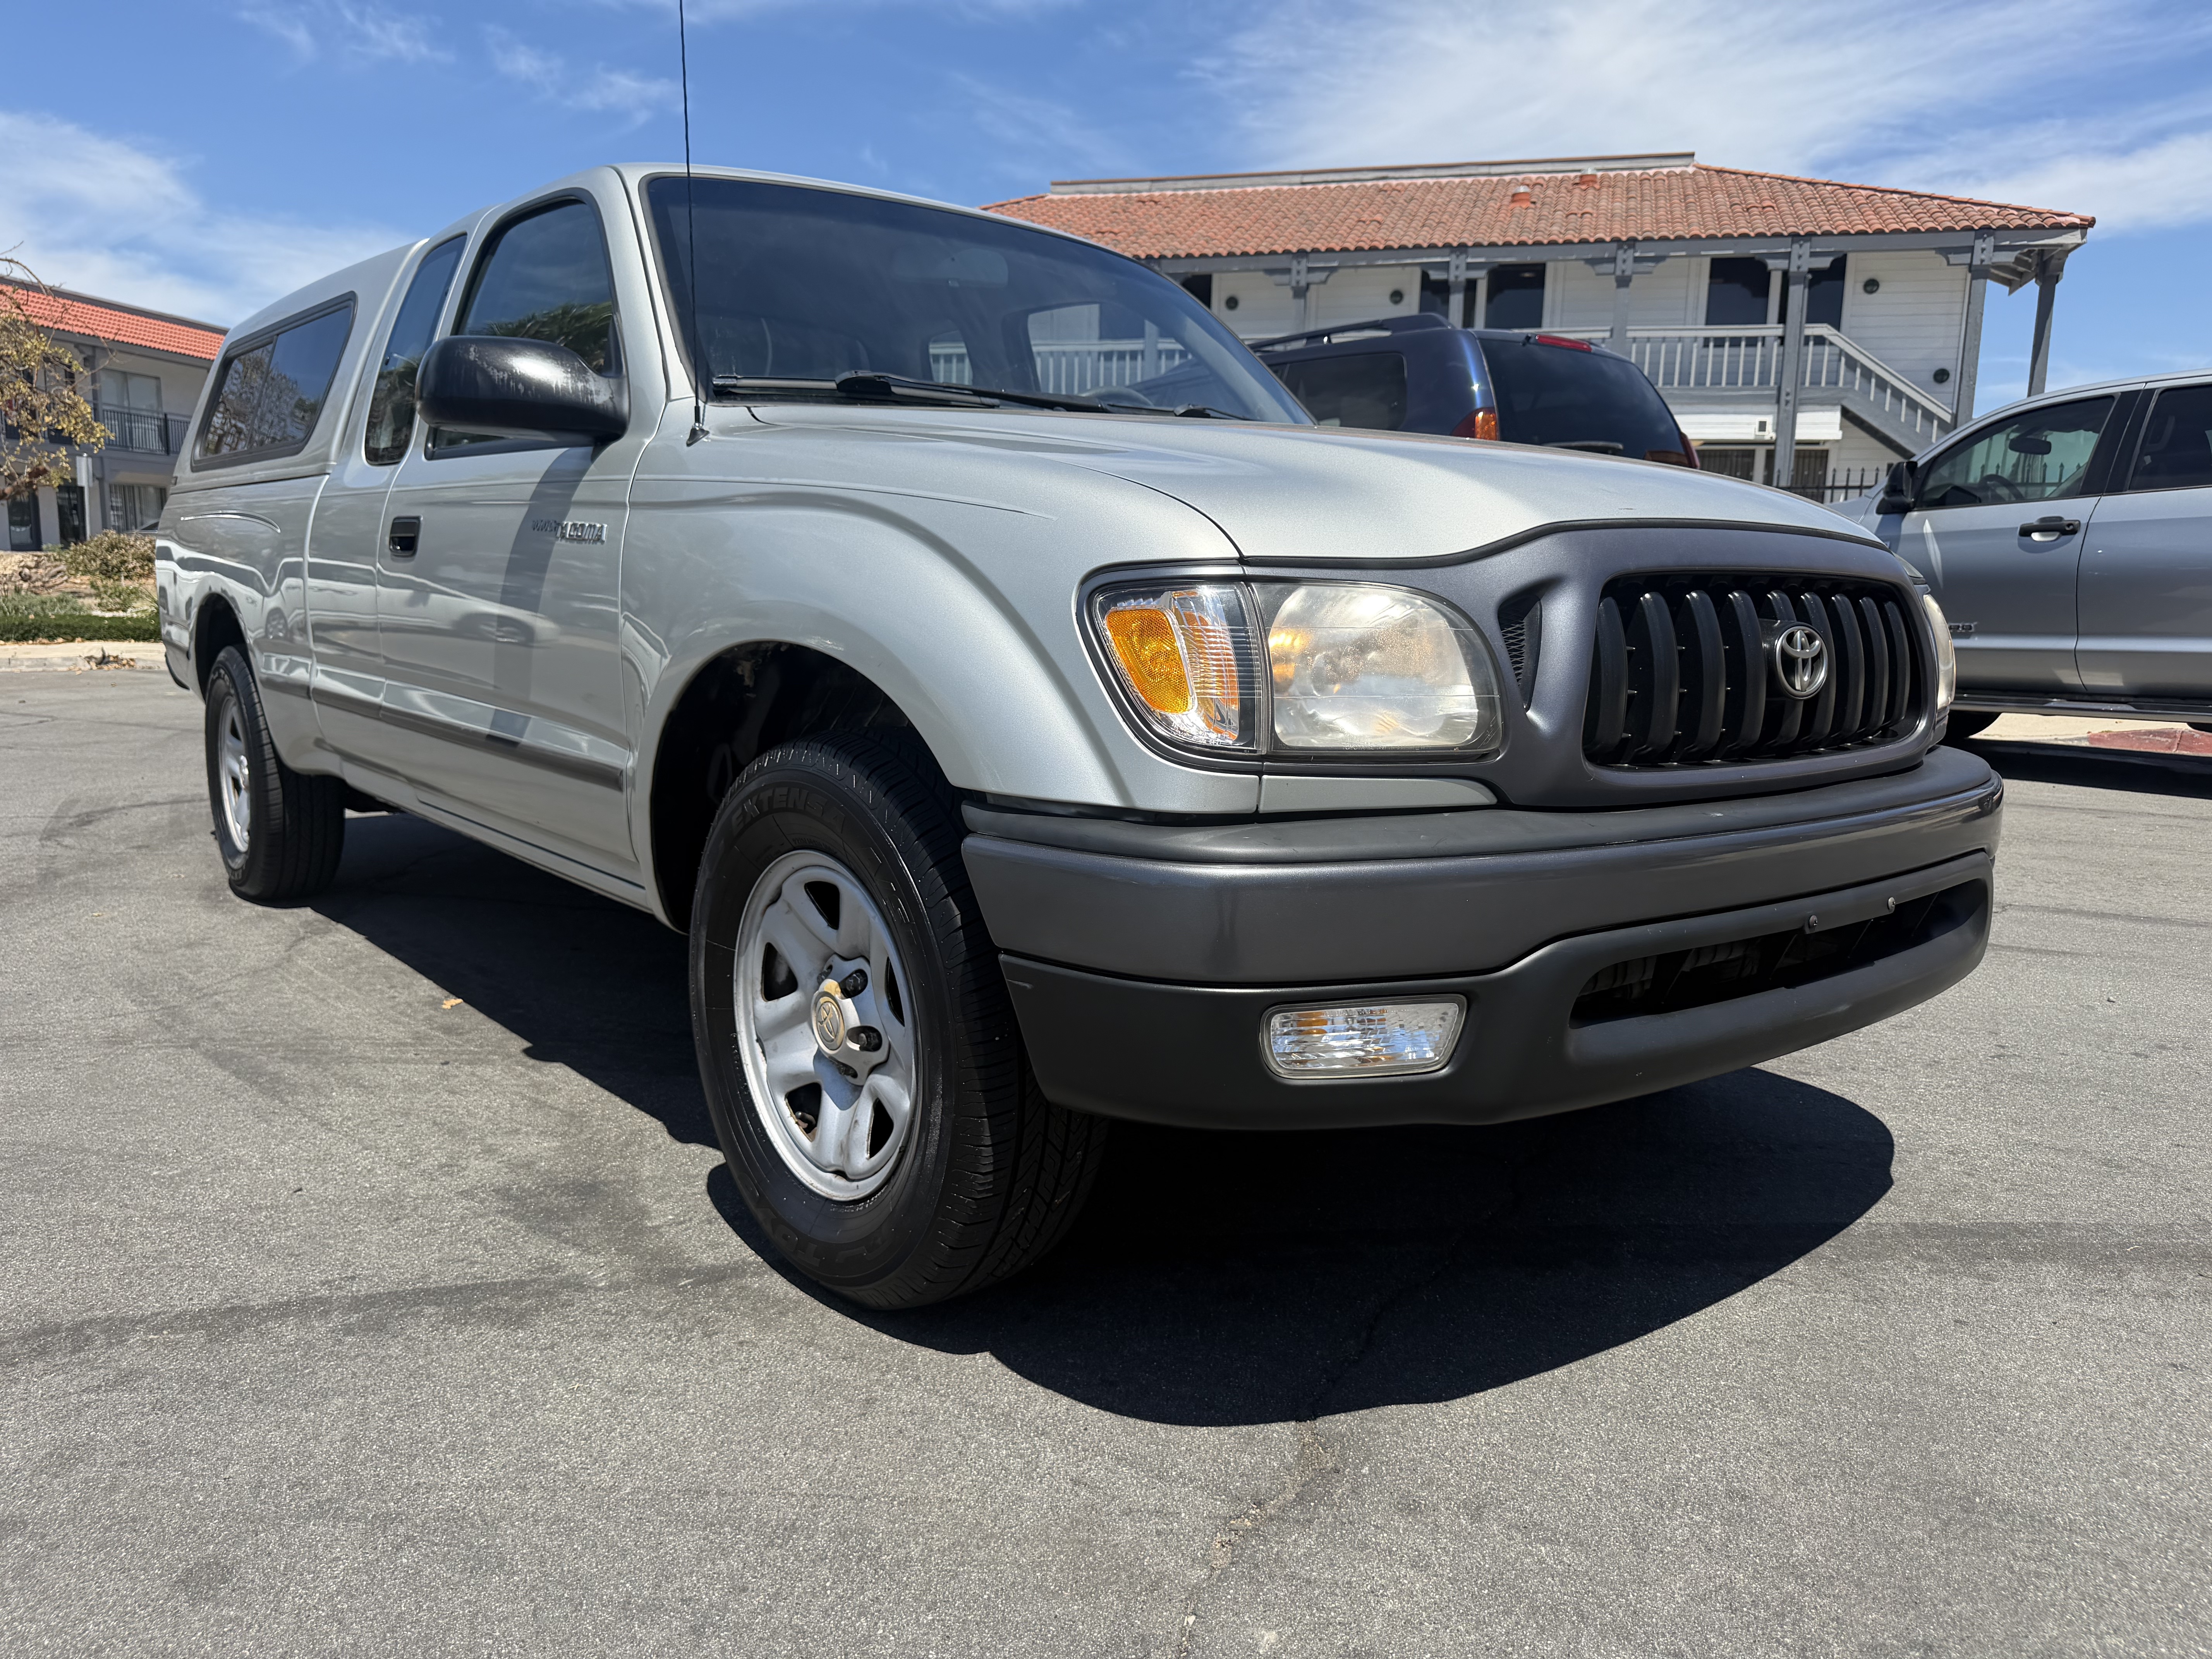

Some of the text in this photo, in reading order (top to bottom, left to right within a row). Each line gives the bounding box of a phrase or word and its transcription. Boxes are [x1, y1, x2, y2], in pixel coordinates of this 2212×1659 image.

[556, 521, 608, 541] TACOMA
[732, 787, 845, 834] EXTENSA
[737, 1173, 820, 1266] TOYO
